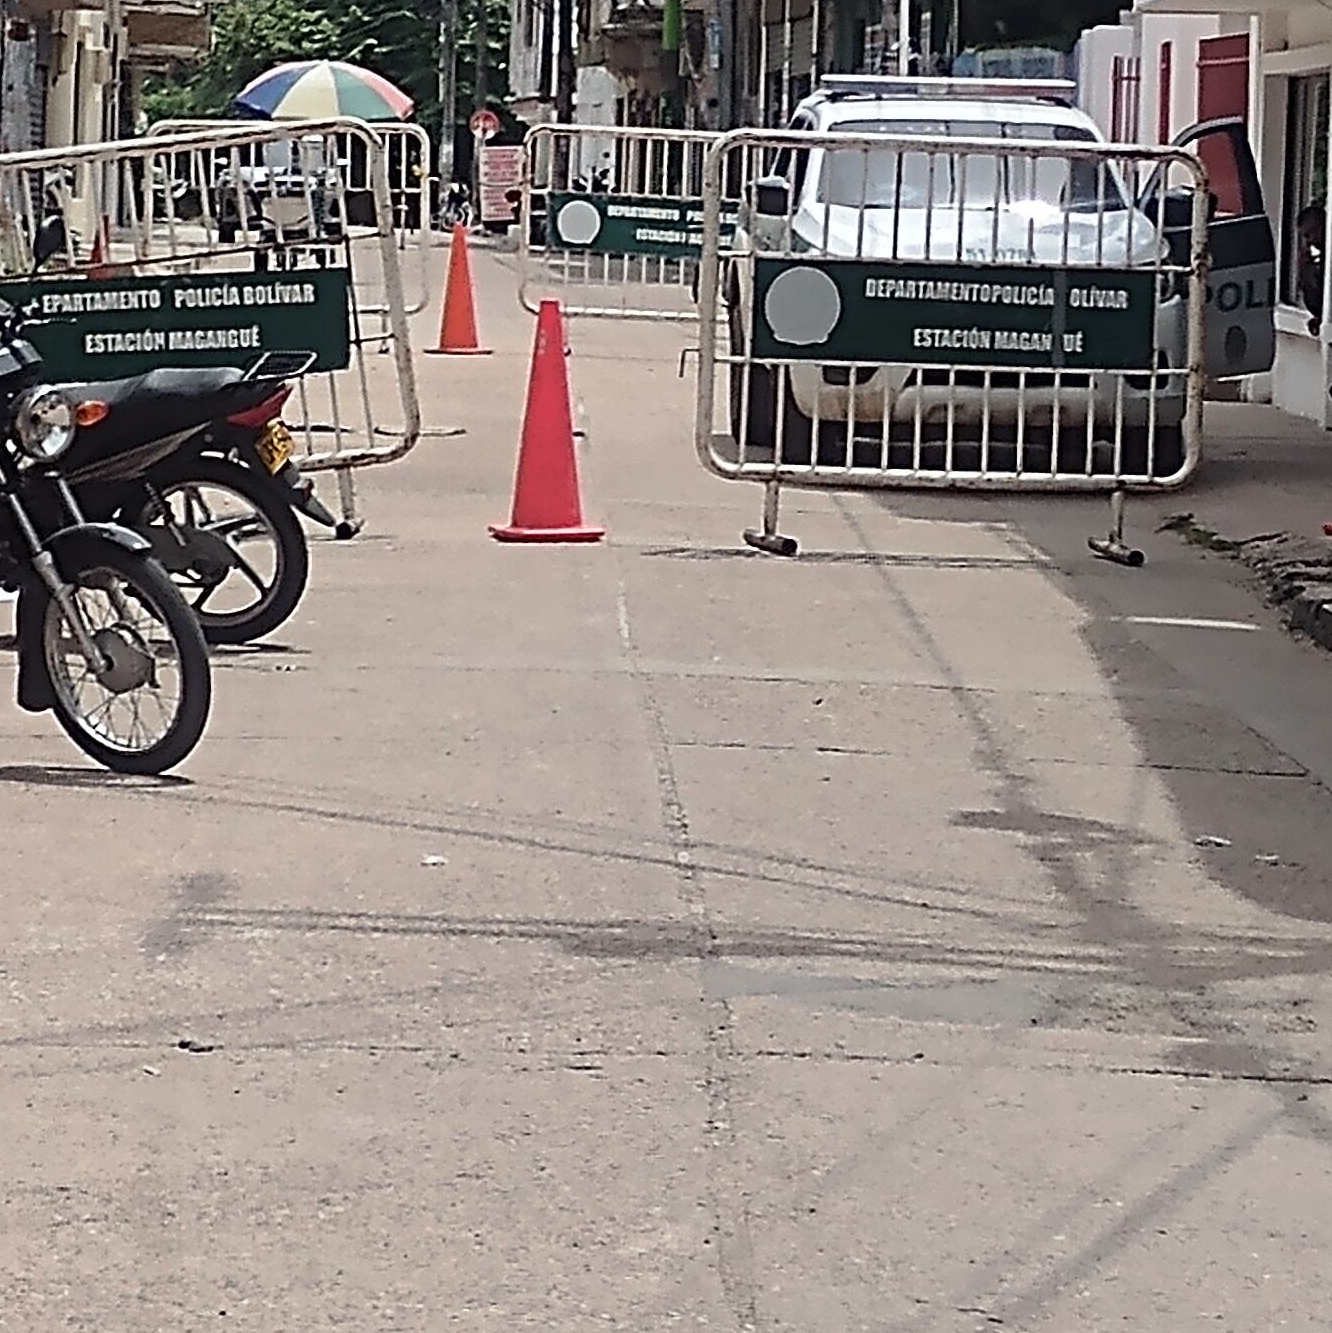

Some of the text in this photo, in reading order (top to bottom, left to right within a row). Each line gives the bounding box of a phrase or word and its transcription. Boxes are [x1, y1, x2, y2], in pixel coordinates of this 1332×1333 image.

[41, 281, 315, 314] EPARTAMENTO POLICÍA BOLÍVAR
[1069, 285, 1129, 309] OLÍVAR
[84, 328, 166, 354] ESTACIÓN
[913, 326, 1084, 353] ESTACIÓN MAGANUÉ
